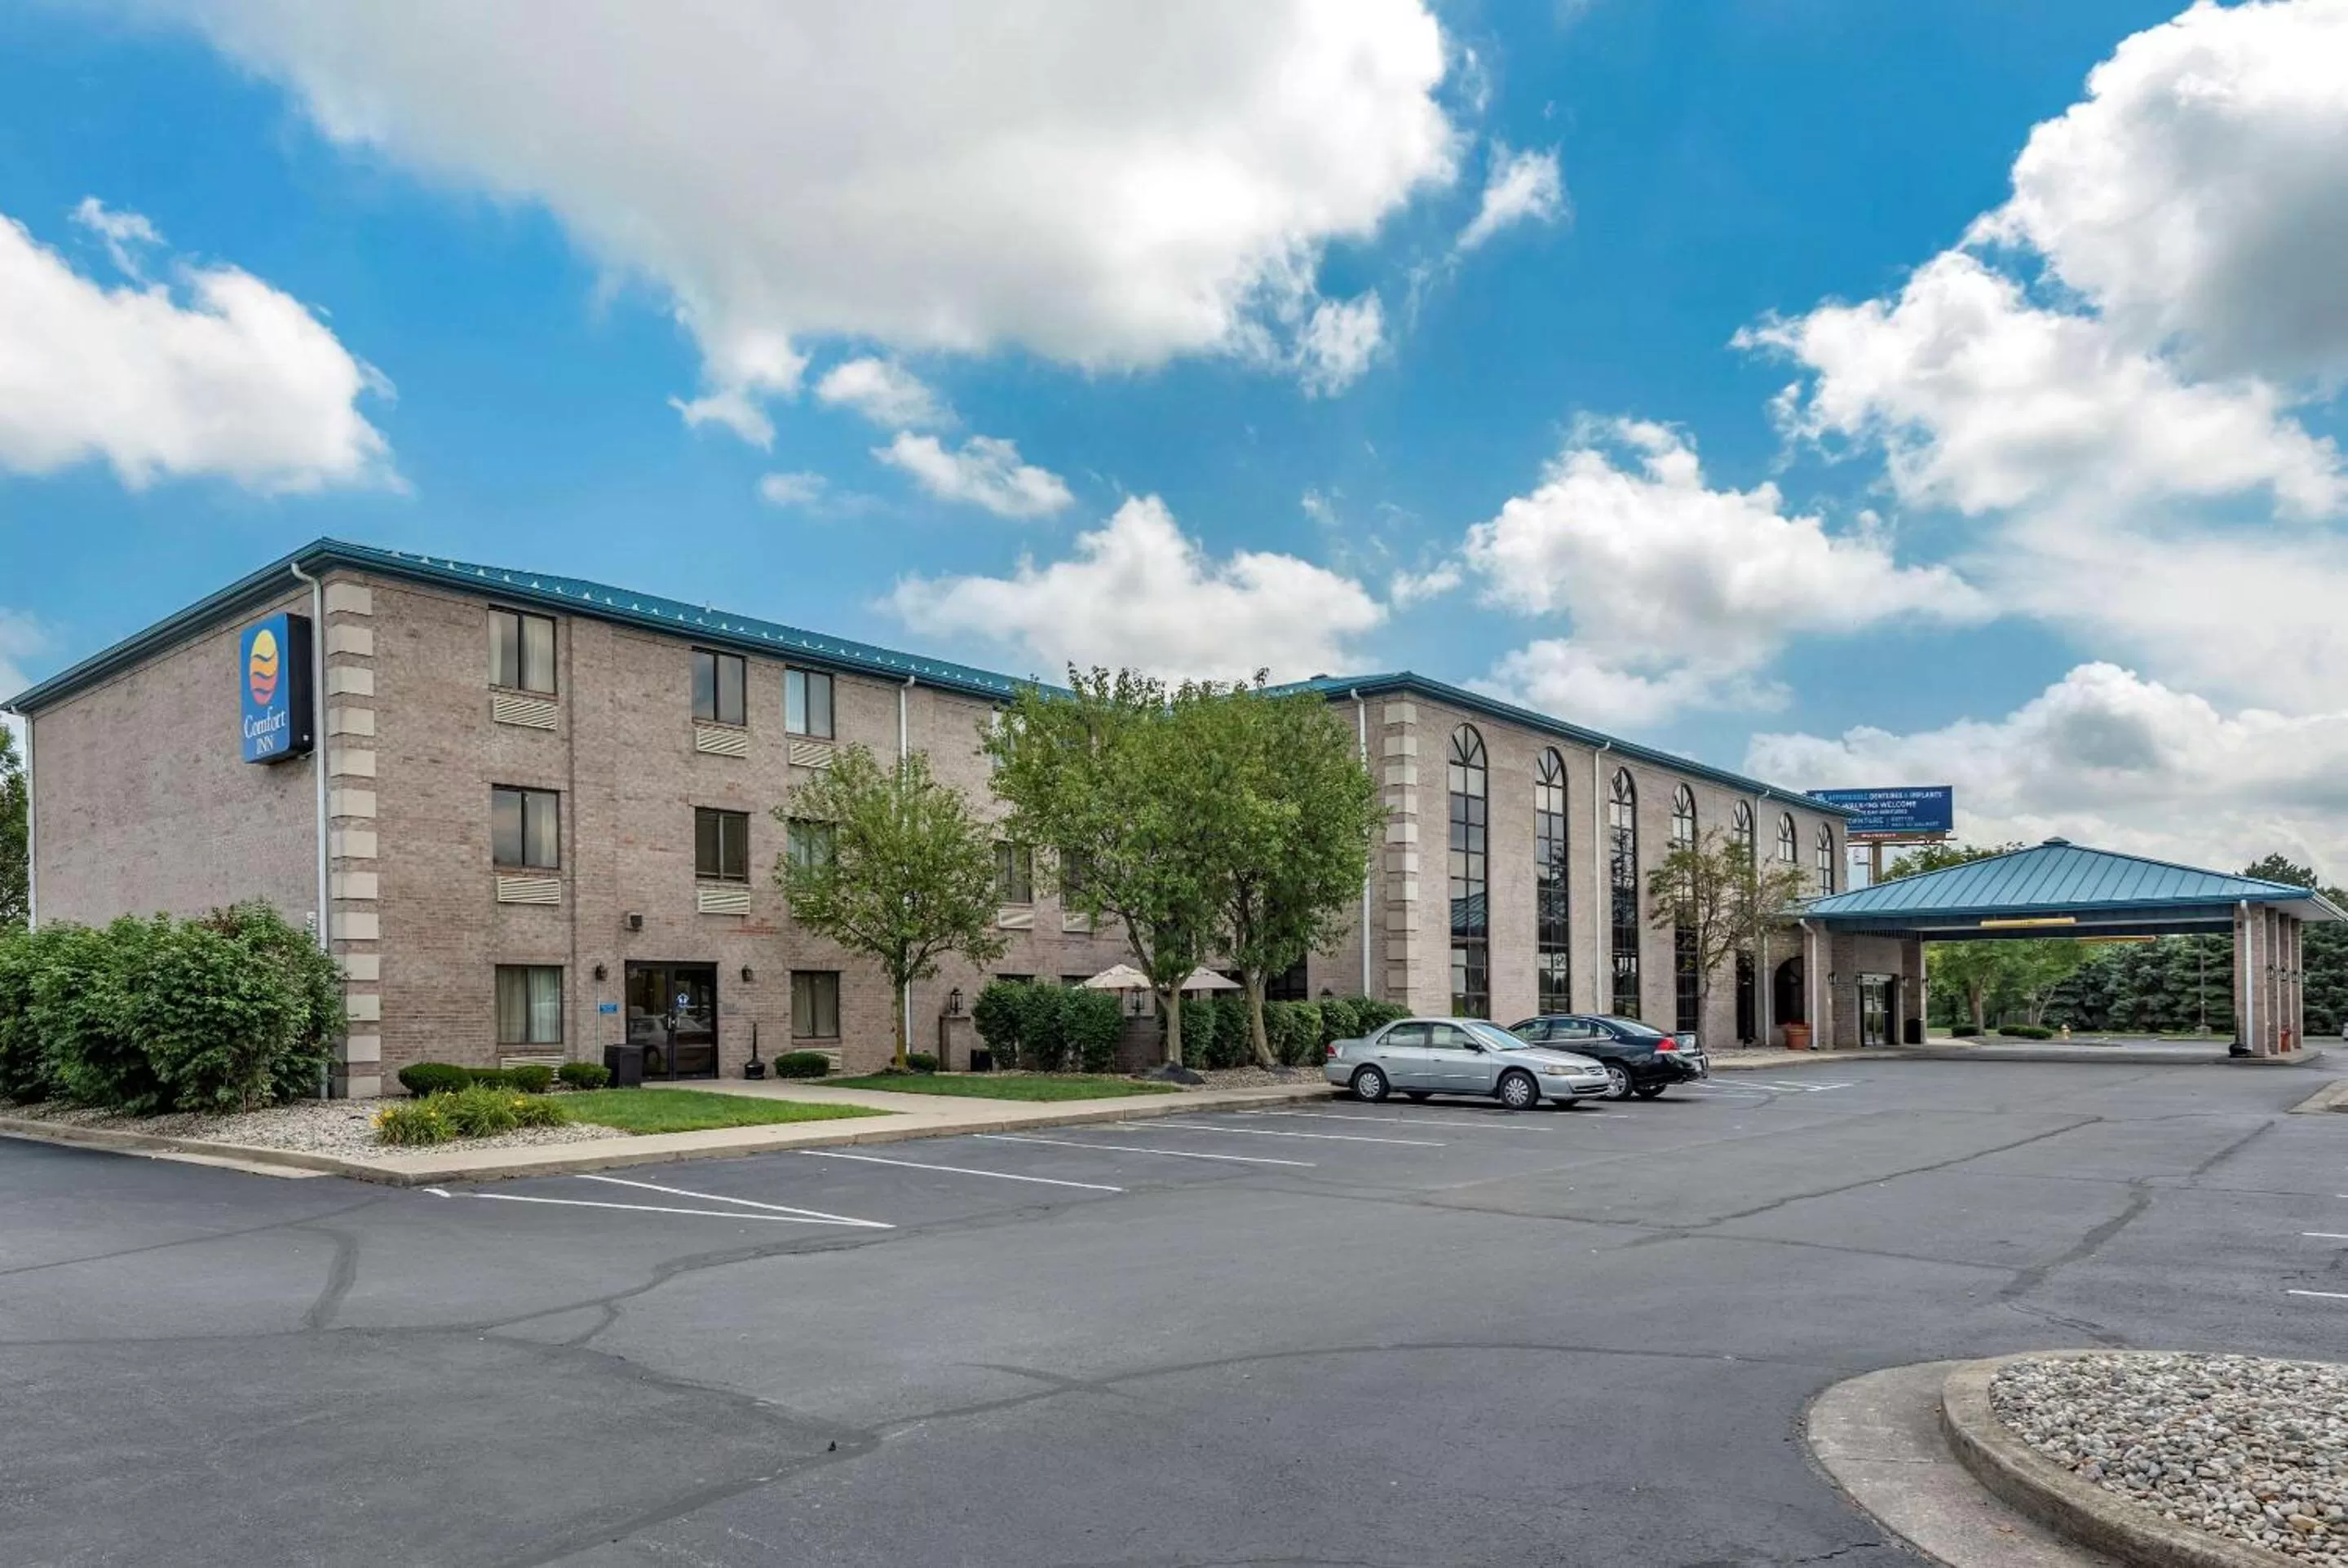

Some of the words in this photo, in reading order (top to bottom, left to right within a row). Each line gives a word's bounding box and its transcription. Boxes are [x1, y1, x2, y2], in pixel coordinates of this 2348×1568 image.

[244, 705, 286, 739] Comfort
[256, 735, 275, 756] INN
[1880, 801, 1917, 809] WELCOME
